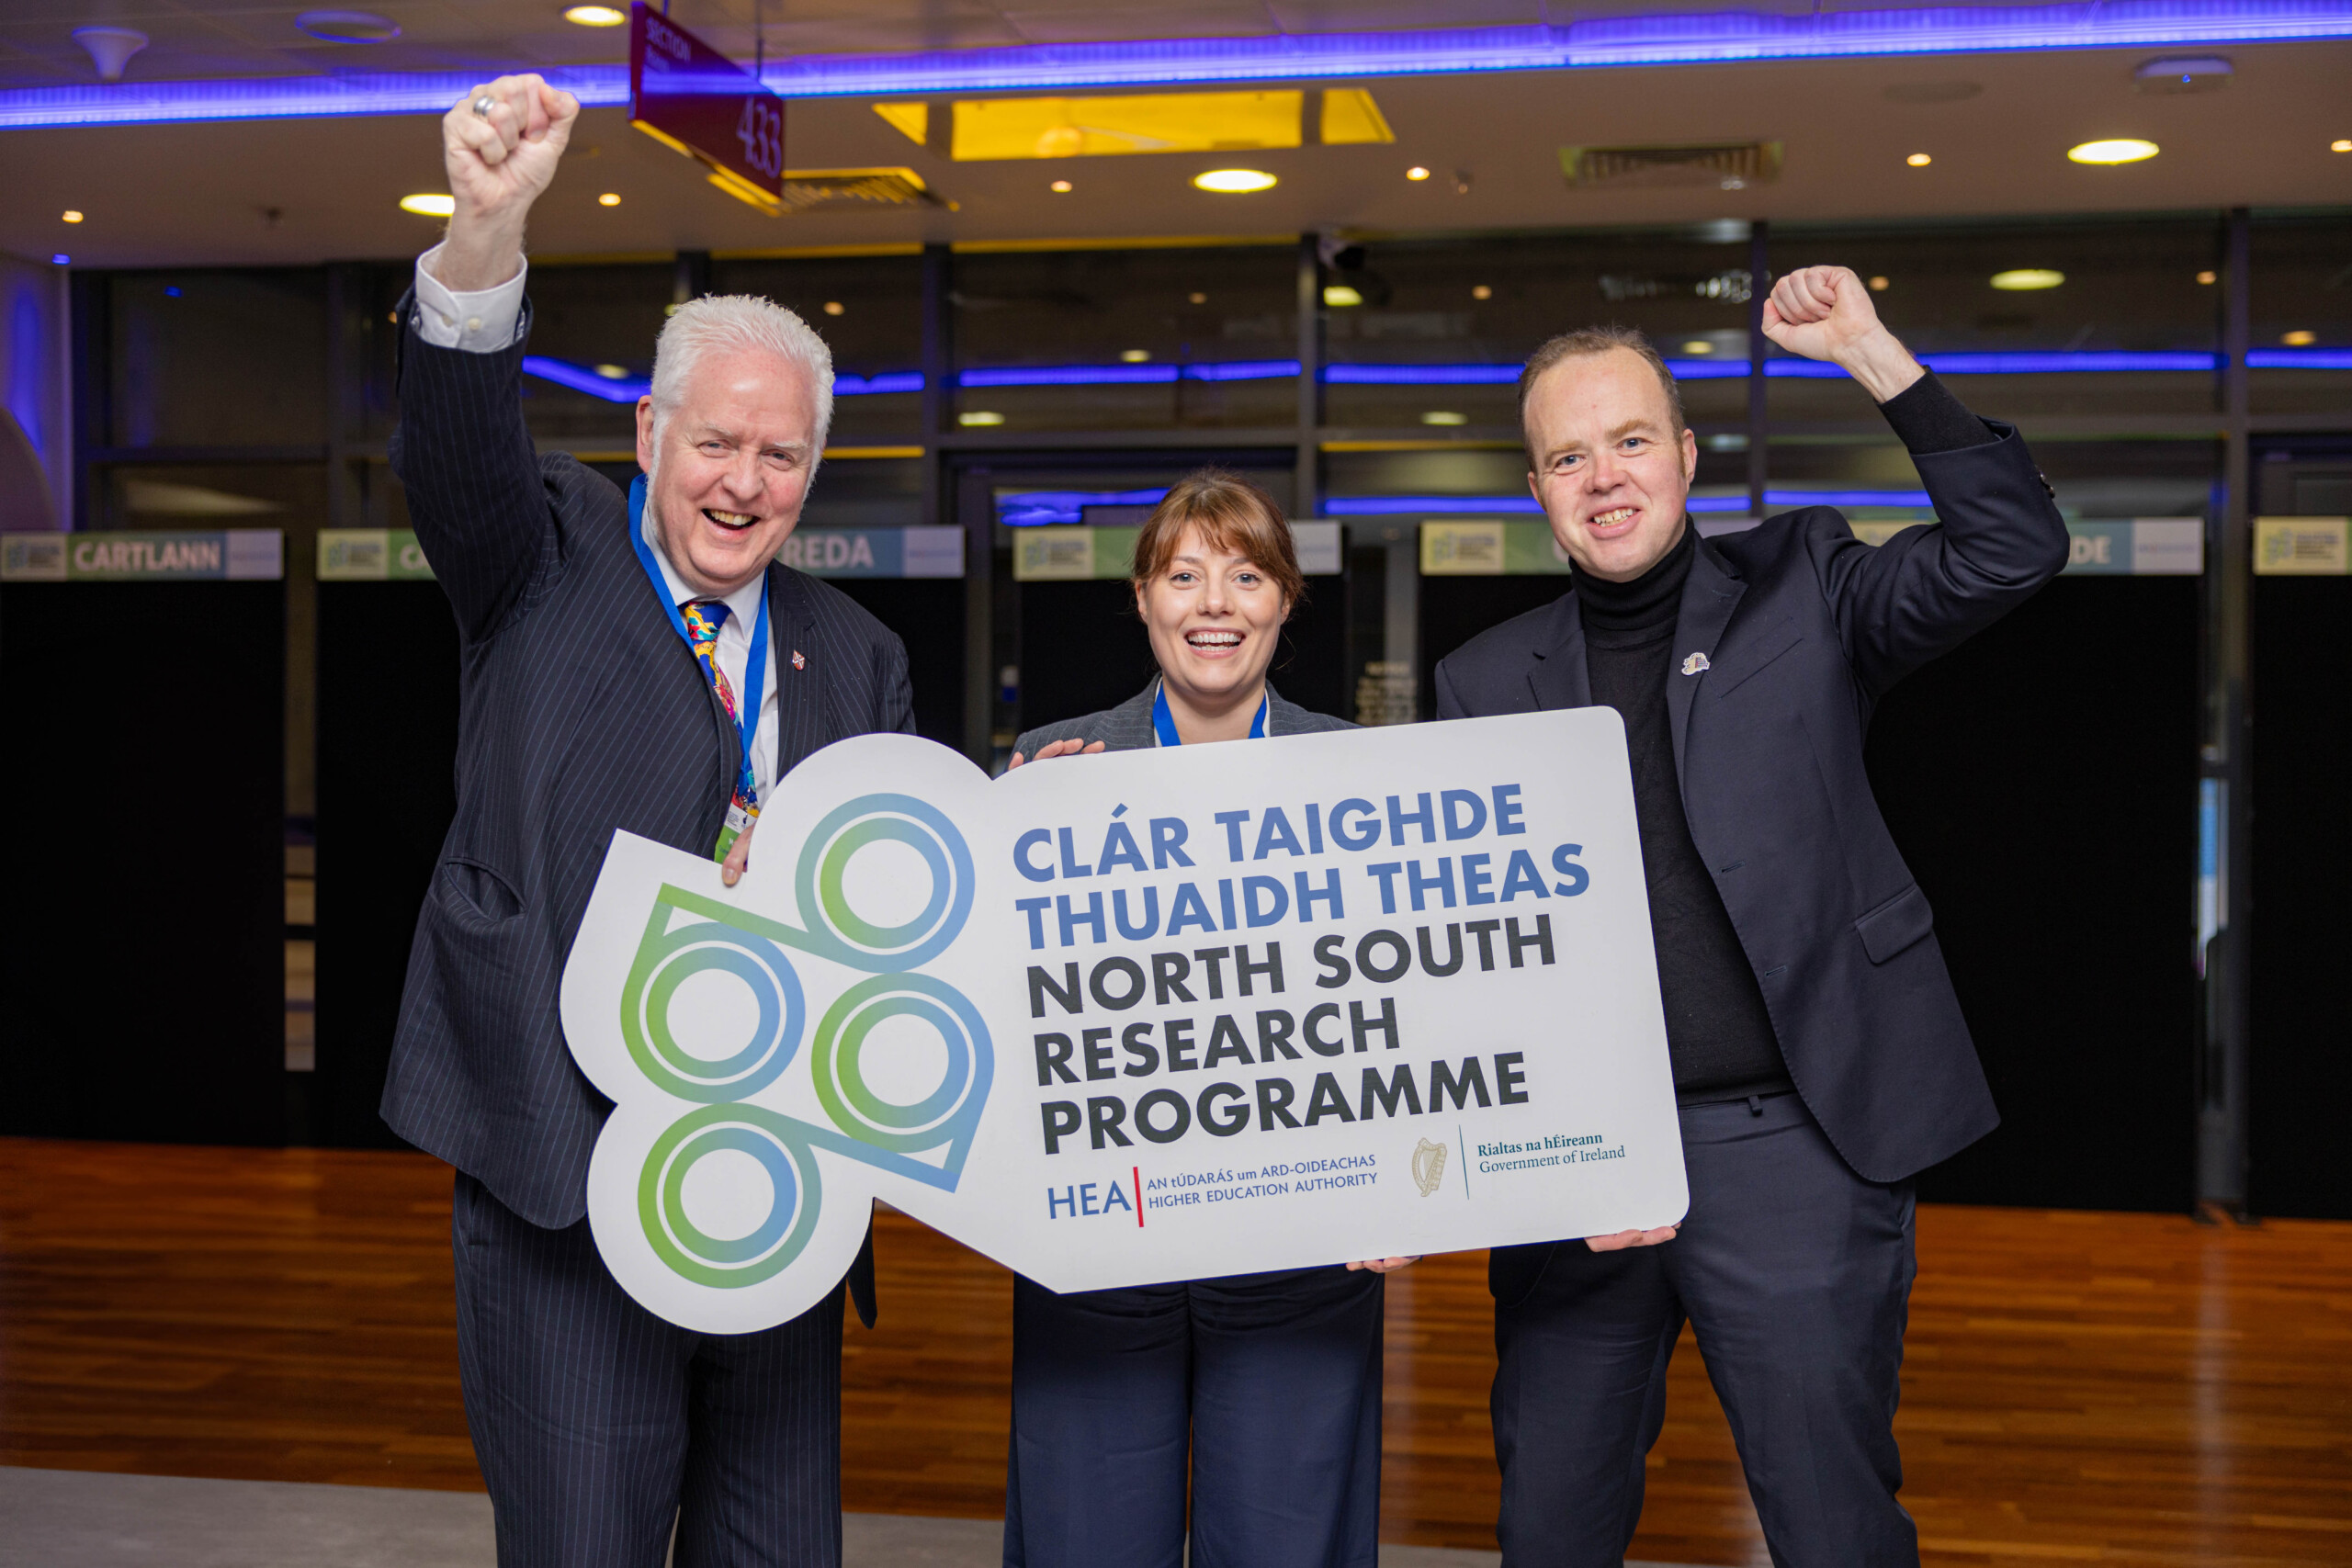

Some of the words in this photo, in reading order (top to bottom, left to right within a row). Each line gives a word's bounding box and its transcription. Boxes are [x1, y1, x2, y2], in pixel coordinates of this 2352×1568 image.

[736, 96, 782, 178] 433
[74, 541, 221, 571] CARTLANN
[1012, 803, 1197, 883] CLÁR
[1214, 783, 1527, 863] TAIGHDE
[1014, 867, 1345, 951] THUAIDH
[1366, 842, 1590, 915] THEAS
[1026, 941, 1286, 1019] NORTH
[1313, 913, 1556, 989] SOUTH
[1033, 997, 1400, 1088] RESEARCH
[1040, 1051, 1530, 1156] PROGRAMME
[1148, 1178, 1168, 1190] AN
[1170, 1168, 1234, 1189] tÚDARÁS
[1237, 1170, 1257, 1181] um
[1261, 1154, 1376, 1179] ARD-OIDEACHAS
[1477, 1141, 1523, 1157] Rialtas
[1525, 1141, 1543, 1152] na
[1544, 1134, 1603, 1150] hÉireann
[1479, 1155, 1561, 1174] Government
[1562, 1149, 1578, 1165] of
[1579, 1145, 1626, 1162] Ireland
[1047, 1179, 1133, 1220] HEA
[1148, 1192, 1202, 1209] HIGHER
[1206, 1182, 1290, 1202] EDUCATION
[1295, 1172, 1378, 1193] AUTHORITY
